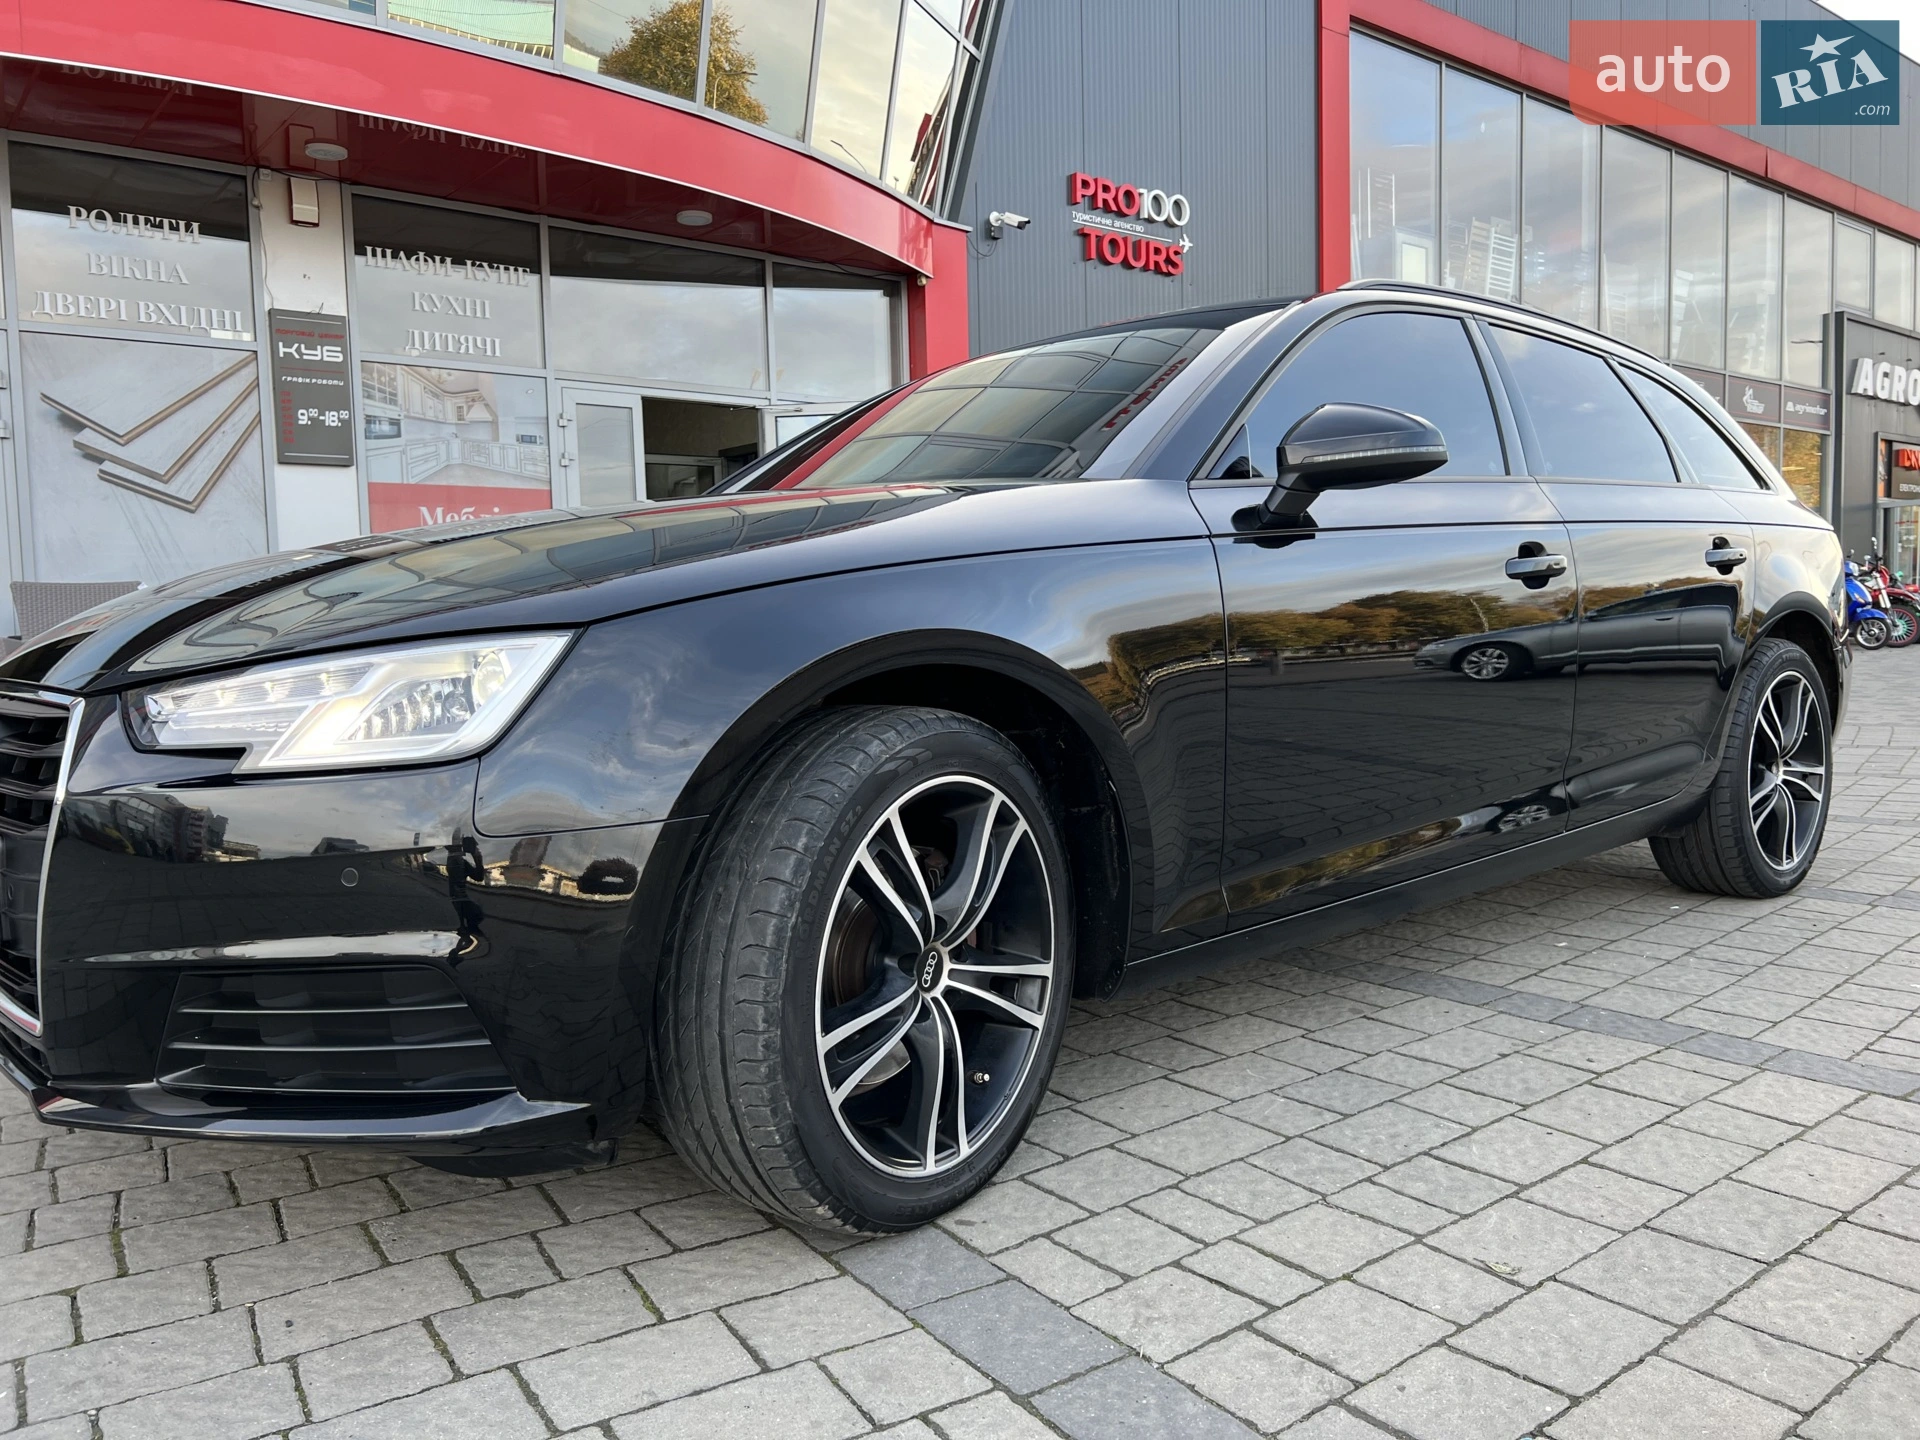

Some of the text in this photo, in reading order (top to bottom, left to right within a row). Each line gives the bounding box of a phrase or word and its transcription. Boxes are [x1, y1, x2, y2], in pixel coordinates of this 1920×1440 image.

[1071, 171, 1191, 227] PRO100
[66, 205, 201, 244] РОЛЕТИ
[1071, 210, 1113, 226] туристичне
[87, 252, 191, 285] ВІКНА
[364, 245, 531, 287] ШАФИ-КУПЕ
[1078, 226, 1185, 276] TOURS
[31, 290, 244, 333] ДВЕРІ ВХІДНІ
[411, 291, 492, 319] КУХНІ
[278, 341, 344, 363] КУБ
[405, 328, 502, 357] ДИТЯЧІ
[1851, 357, 1920, 406] AGRO
[418, 506, 501, 527] Меб
